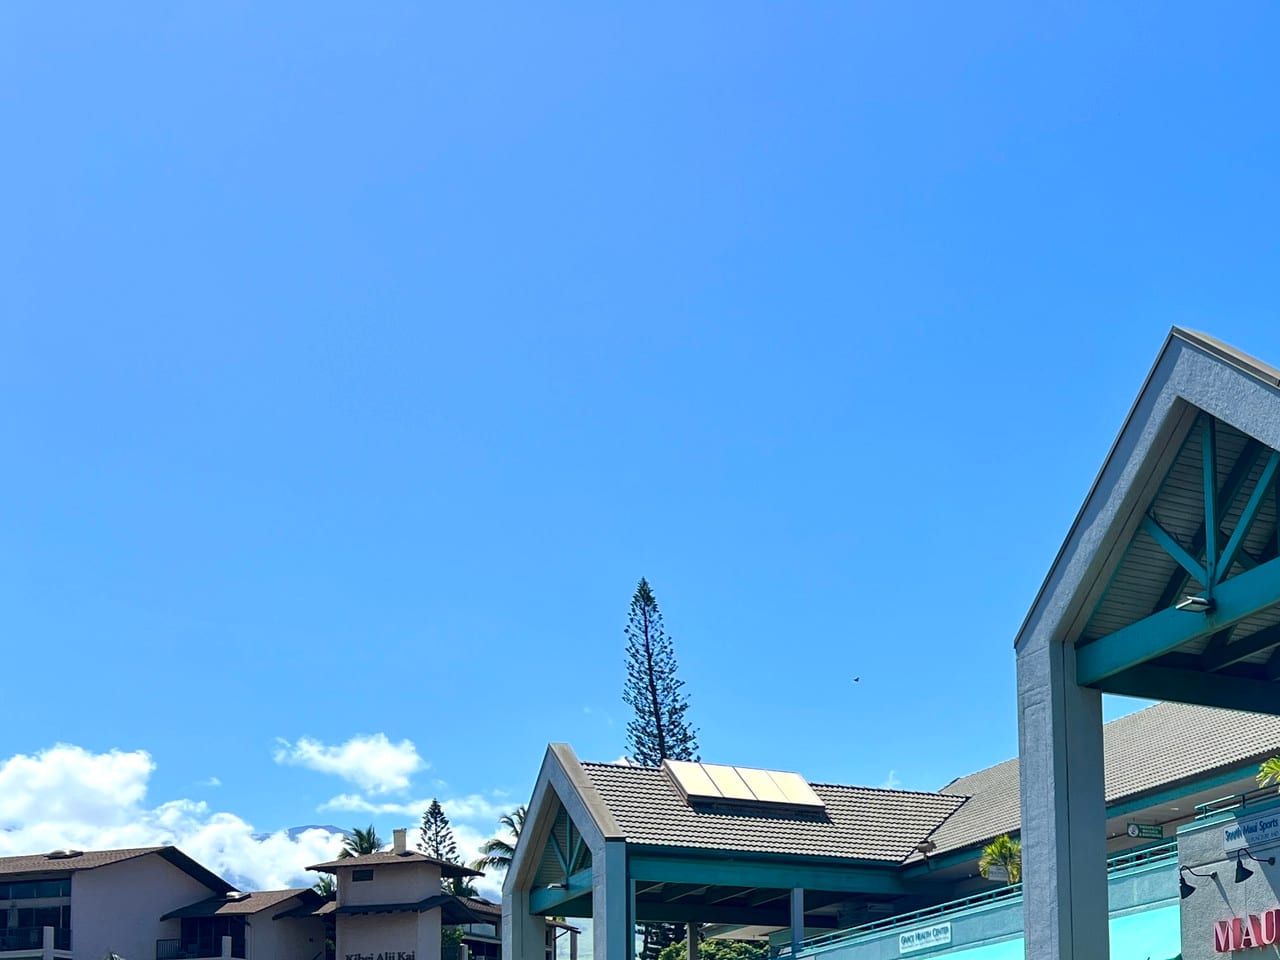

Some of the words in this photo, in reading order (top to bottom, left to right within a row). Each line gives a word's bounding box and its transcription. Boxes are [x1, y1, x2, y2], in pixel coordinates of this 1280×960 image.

[1225, 825, 1242, 842] South
[1243, 821, 1258, 834] Maui
[1259, 817, 1279, 832] Sports
